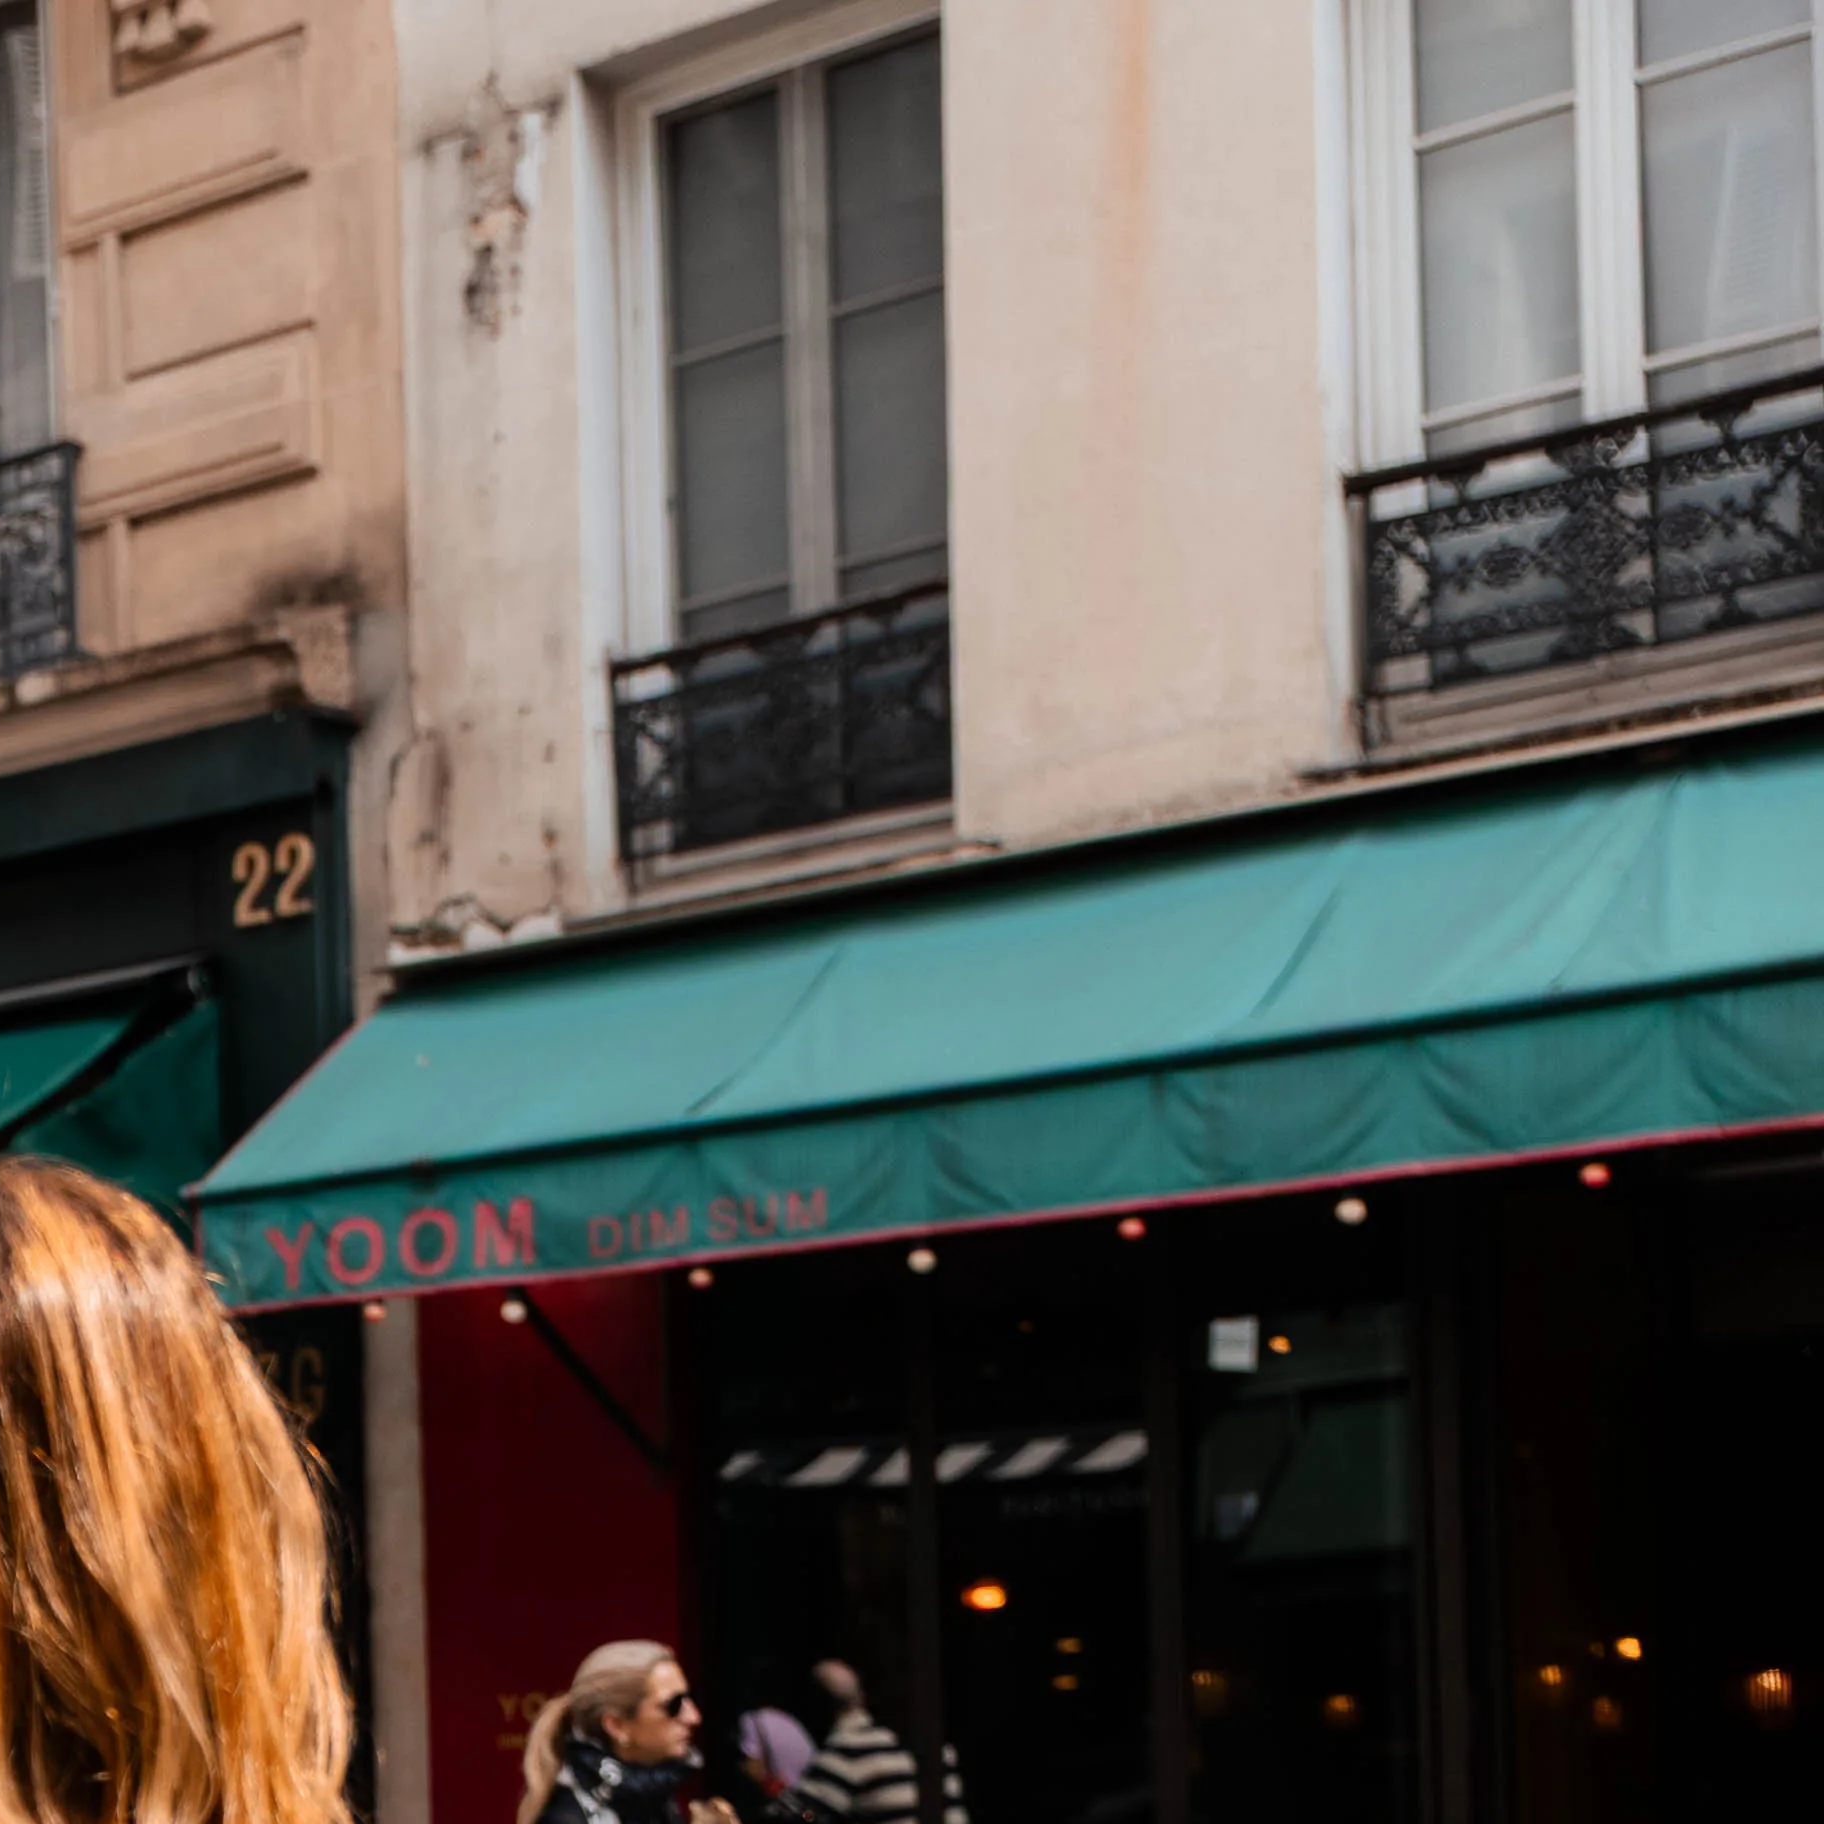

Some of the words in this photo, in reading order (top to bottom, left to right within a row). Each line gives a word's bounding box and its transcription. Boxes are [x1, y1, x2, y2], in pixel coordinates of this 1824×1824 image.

[232, 832, 315, 928] 22
[265, 1196, 536, 1290] YOOM
[588, 1207, 690, 1258] DIM
[708, 1189, 827, 1242] SUM
